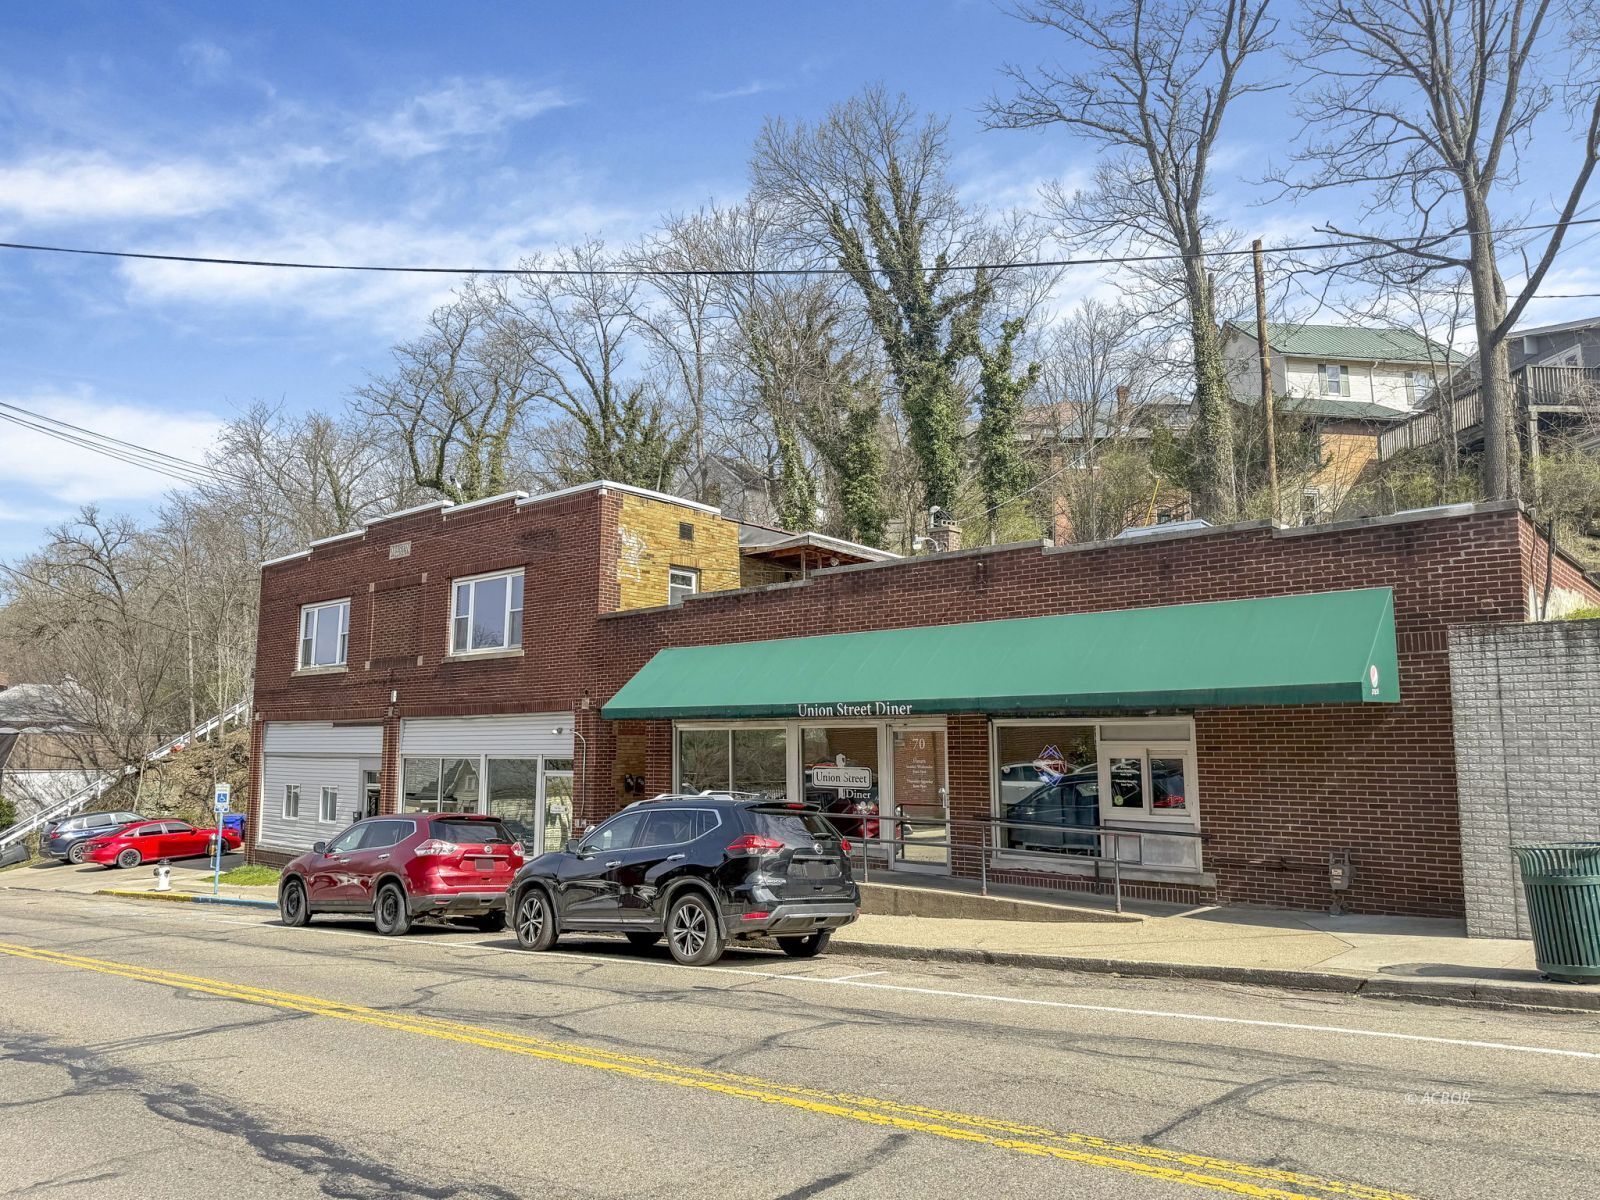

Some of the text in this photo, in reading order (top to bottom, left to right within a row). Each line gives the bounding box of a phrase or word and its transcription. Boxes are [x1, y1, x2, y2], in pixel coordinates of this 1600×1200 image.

[798, 701, 912, 717] Union Street Diner
[912, 738, 925, 750] 70
[816, 771, 867, 783] Union Street
[846, 789, 871, 799] Diner
